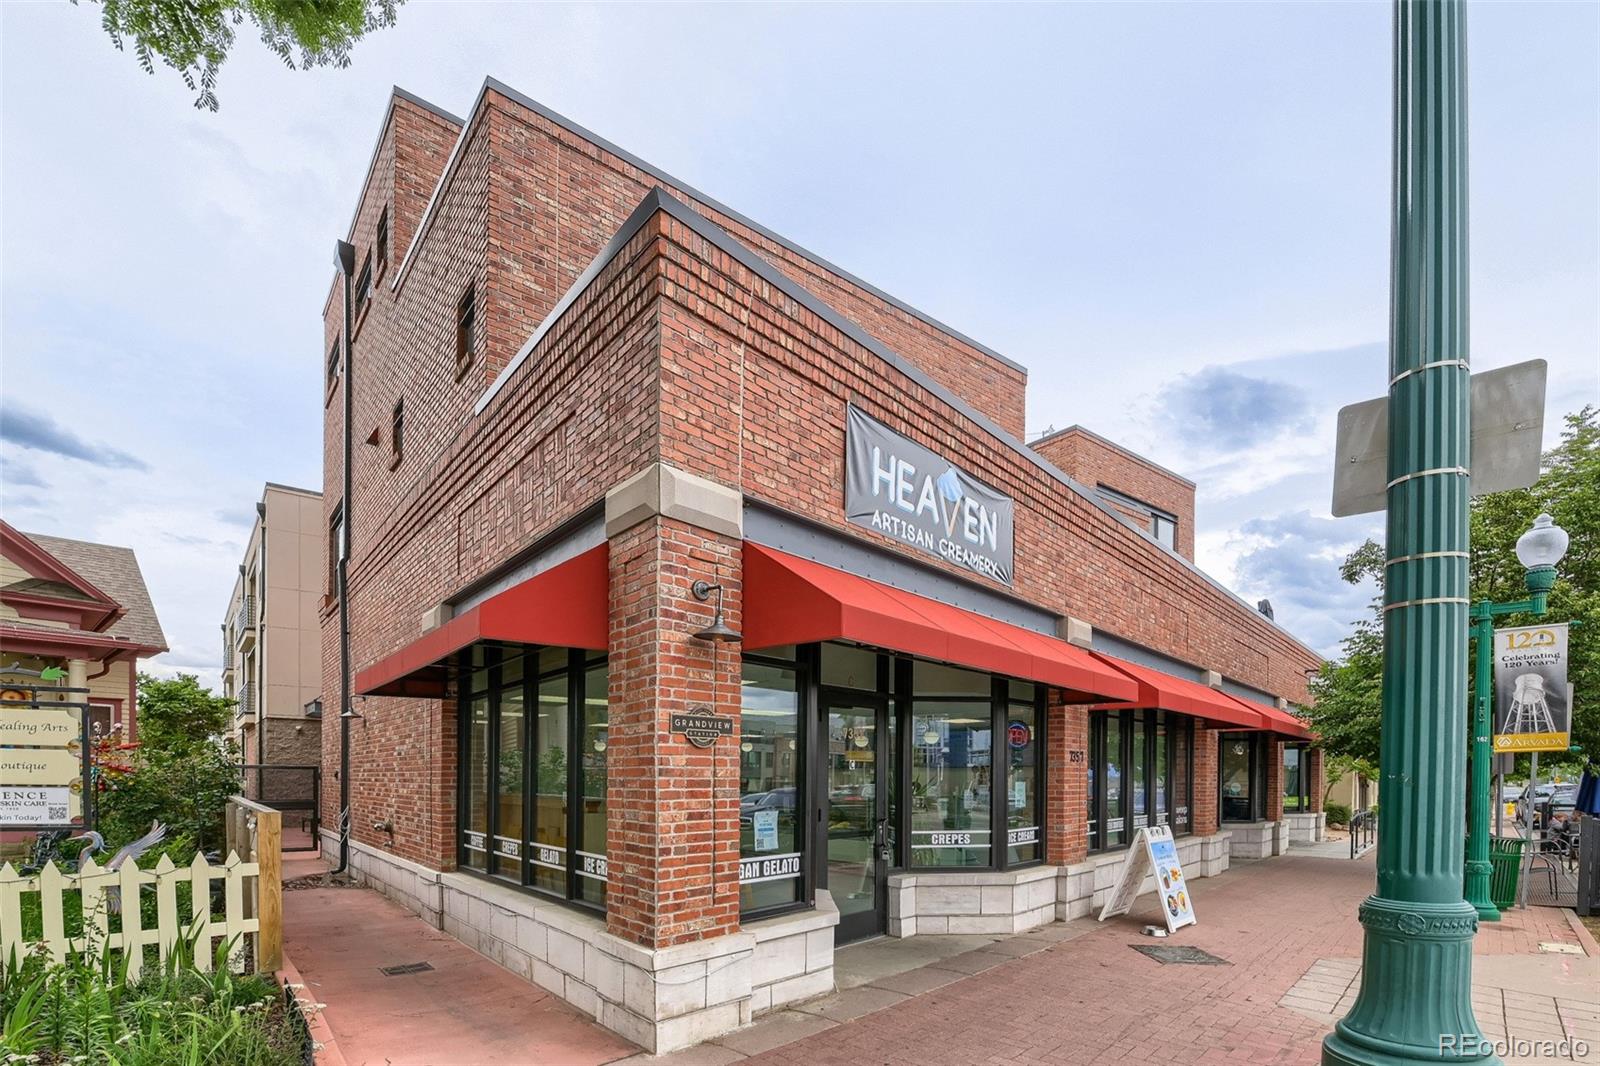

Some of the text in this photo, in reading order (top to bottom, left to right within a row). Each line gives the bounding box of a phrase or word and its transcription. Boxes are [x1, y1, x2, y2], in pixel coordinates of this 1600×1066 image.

[872, 446, 997, 552] HEAVEN
[872, 509, 998, 577] ARTISAN CREAMERY
[1501, 652, 1561, 662] Celebrating
[1525, 658, 1558, 667] Years!
[0, 719, 69, 734] ealing Arts
[674, 718, 731, 729] GRANDVIEW
[1512, 736, 1563, 748] ARVADA
[3, 791, 48, 800] ENCE
[14, 814, 42, 822] Today!
[931, 833, 971, 845] CREPES
[1008, 832, 1017, 843] ICE
[540, 848, 560, 865] GELATO
[738, 857, 800, 879] GAN GELATO
